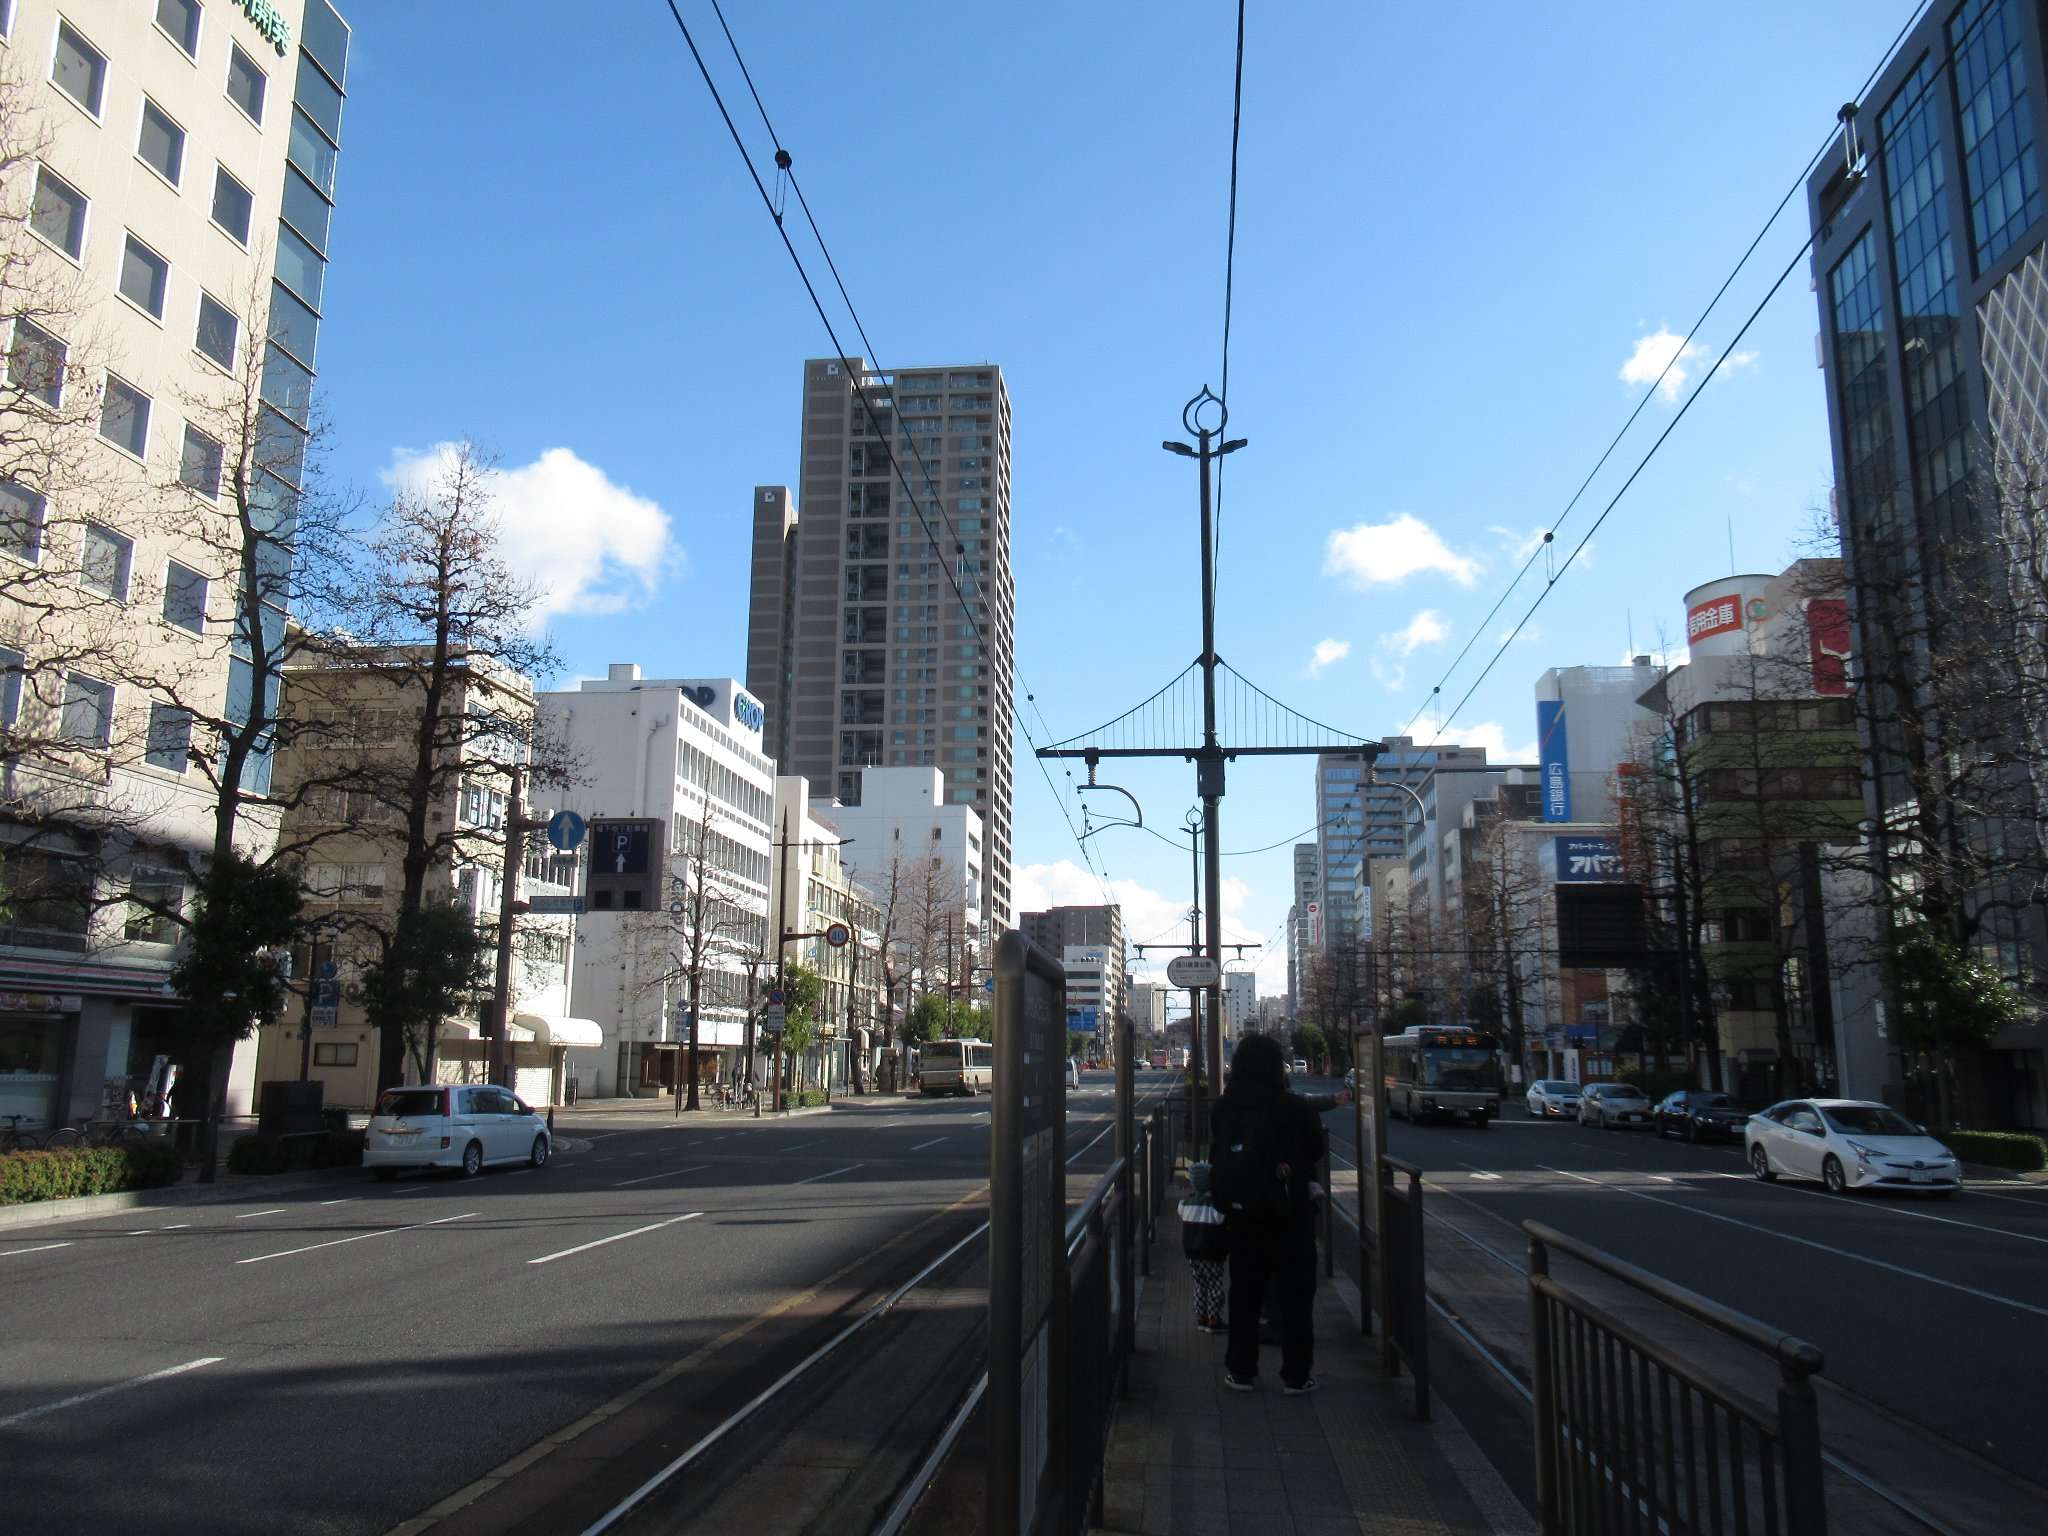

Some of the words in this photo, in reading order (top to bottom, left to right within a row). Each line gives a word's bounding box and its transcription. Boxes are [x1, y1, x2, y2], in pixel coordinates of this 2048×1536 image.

[1548, 762, 1566, 816] 広島銀行
[617, 835, 628, 849] P
[832, 930, 845, 942] 40
